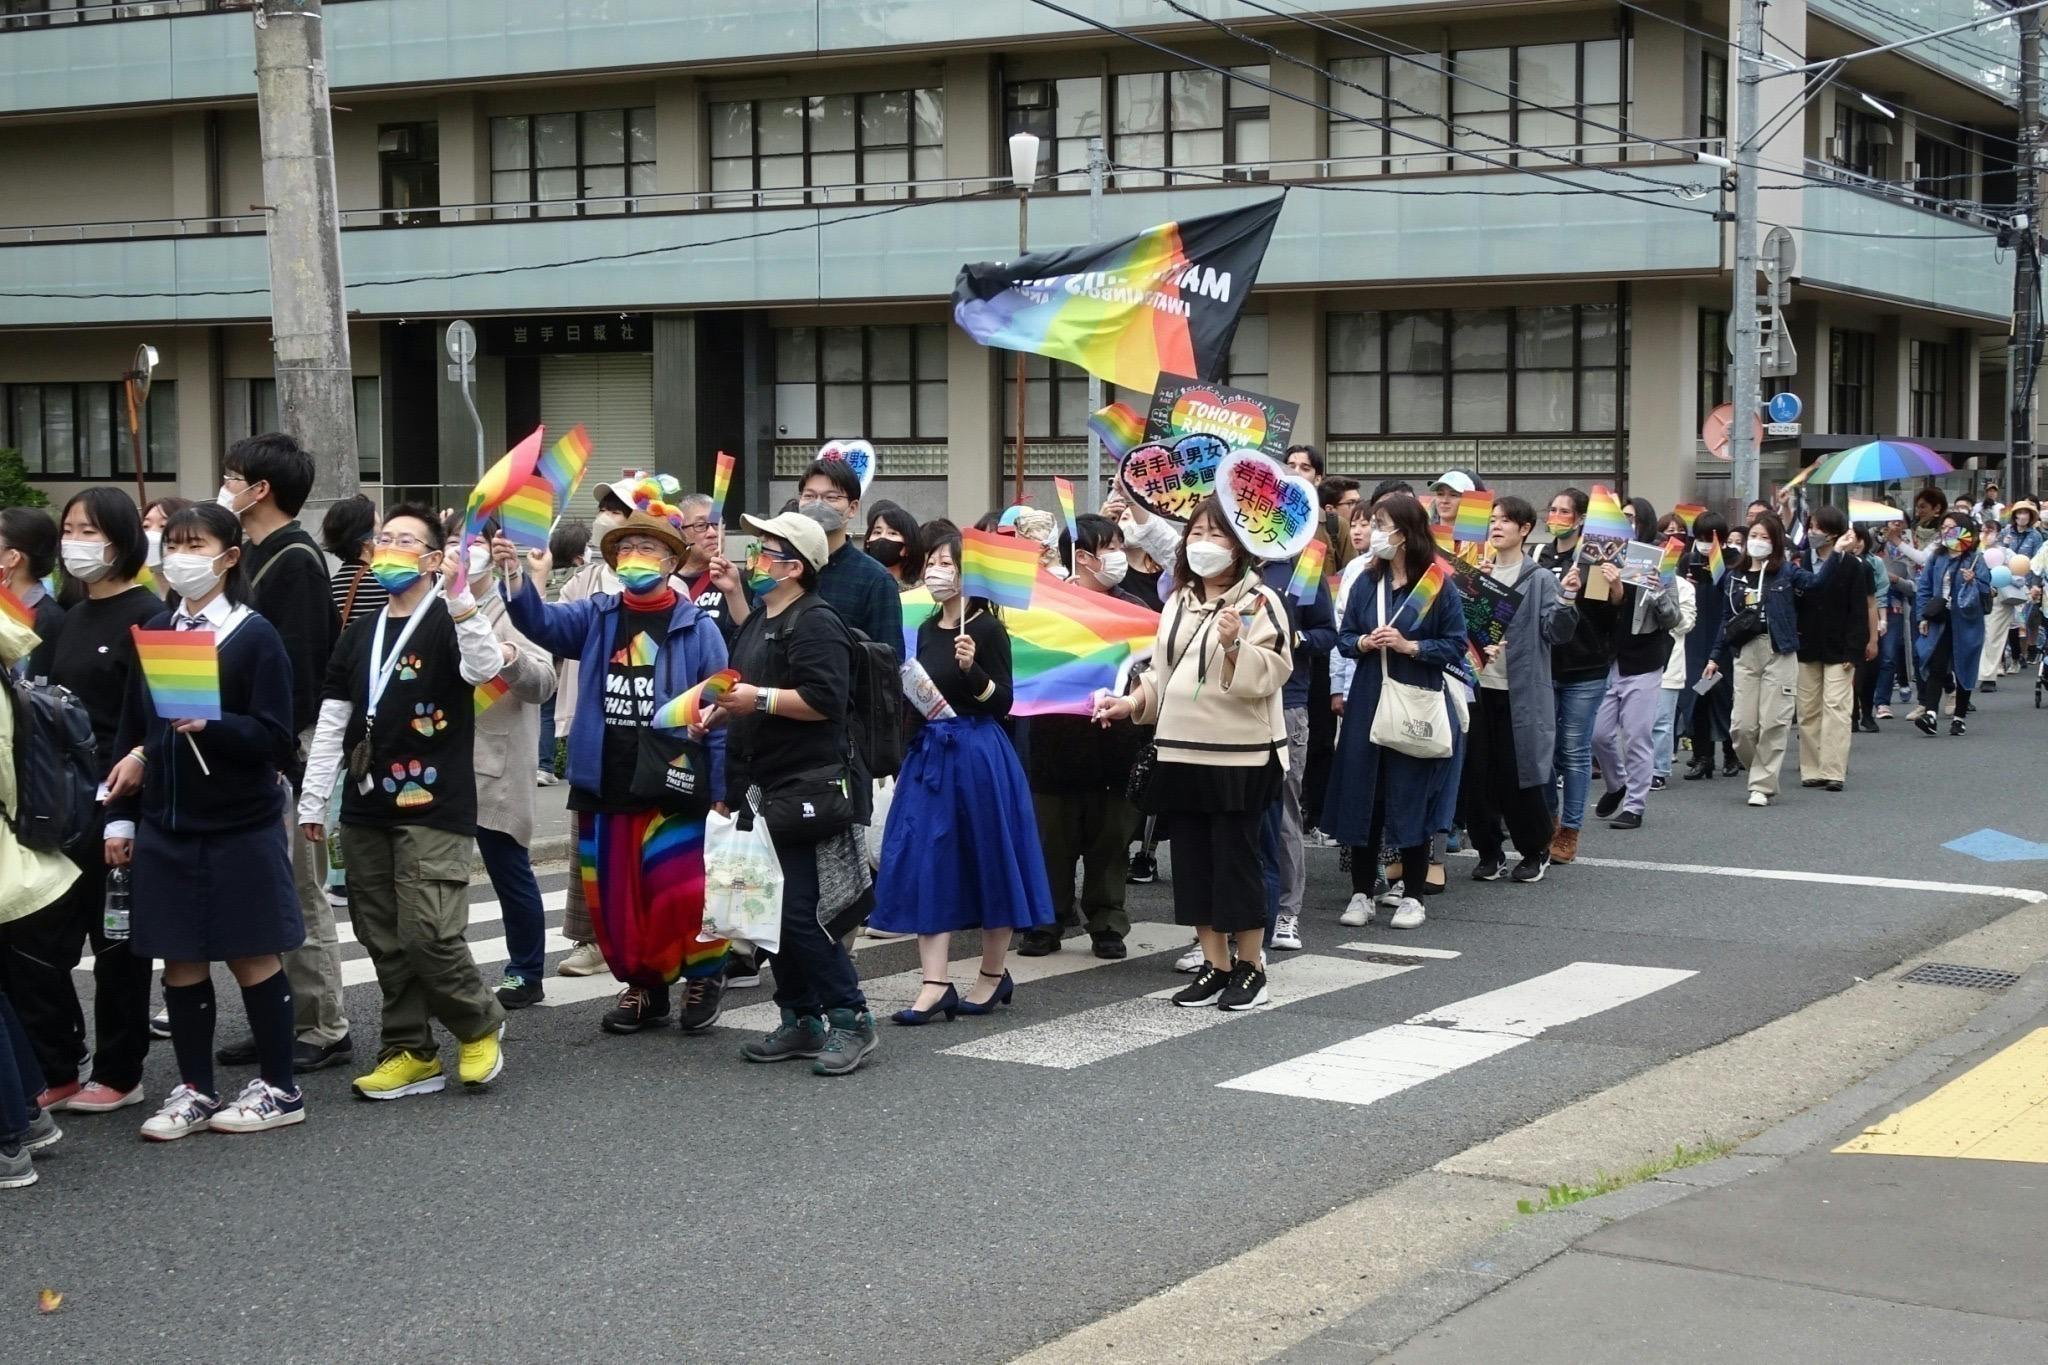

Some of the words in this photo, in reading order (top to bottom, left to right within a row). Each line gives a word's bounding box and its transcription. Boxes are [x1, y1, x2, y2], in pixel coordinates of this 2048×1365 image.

[513, 323, 634, 342] 岩手日報社
[1188, 400, 1253, 429] TOHOKU
[1181, 417, 1251, 446] RAINBOW
[1130, 442, 1223, 479] 岩手県男女
[1145, 464, 1216, 497] 共同参画
[1234, 459, 1312, 522] 岩手県男女
[1237, 485, 1300, 539] 共同参画
[1233, 508, 1287, 551] センター
[1445, 662, 1465, 677] LUSH
[1412, 718, 1425, 727] THE
[667, 768, 695, 783] MARCH
[667, 776, 681, 787] THIS
[681, 781, 695, 790] WAY
